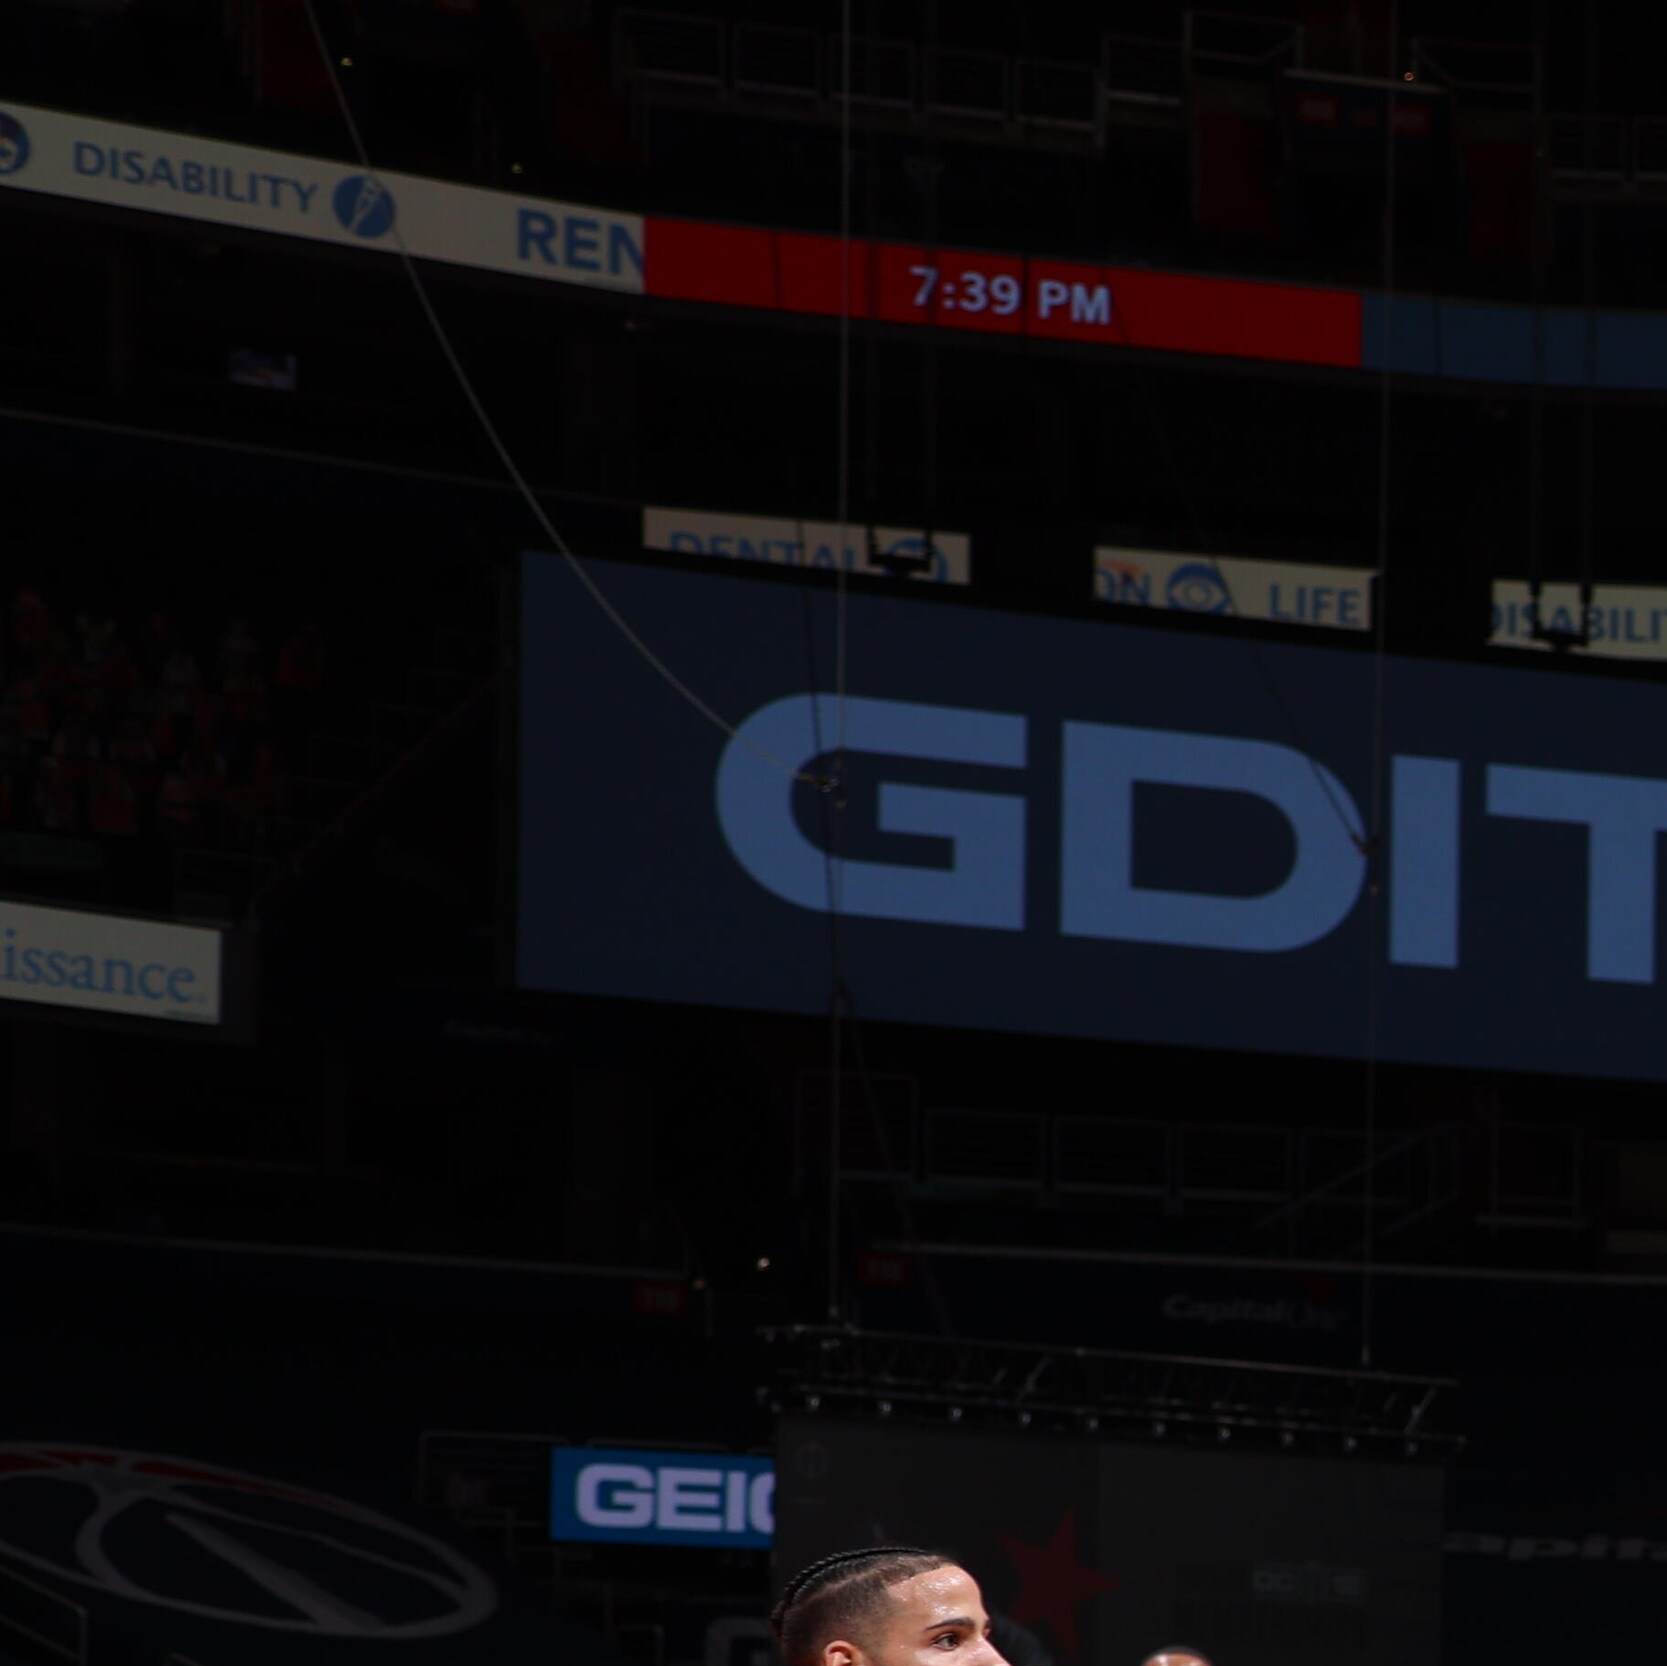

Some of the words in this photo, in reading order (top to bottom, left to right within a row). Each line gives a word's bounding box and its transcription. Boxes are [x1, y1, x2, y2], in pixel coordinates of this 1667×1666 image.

[74, 141, 318, 213] DISABILITY
[909, 266, 1021, 316] 7:39
[1038, 283, 1111, 325] PM
[1268, 584, 1362, 625] LIFE
